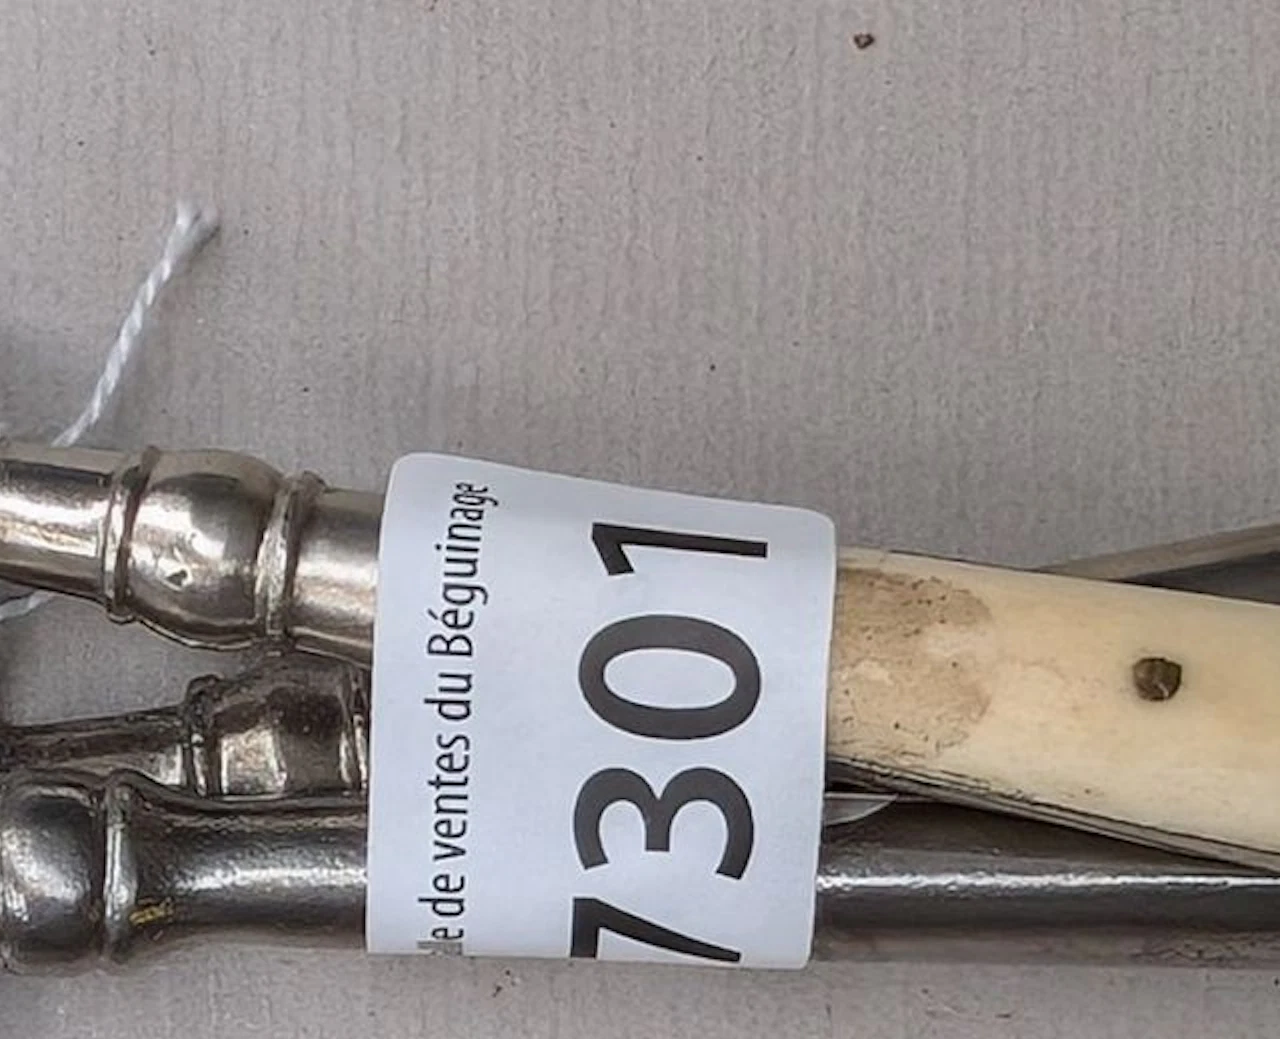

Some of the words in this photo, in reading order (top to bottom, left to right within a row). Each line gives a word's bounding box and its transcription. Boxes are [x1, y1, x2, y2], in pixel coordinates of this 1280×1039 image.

[427, 482, 499, 656] Béguinage
[423, 673, 473, 721] du
[570, 522, 768, 963] 7301
[427, 734, 470, 861] ventes
[418, 873, 464, 917] de
